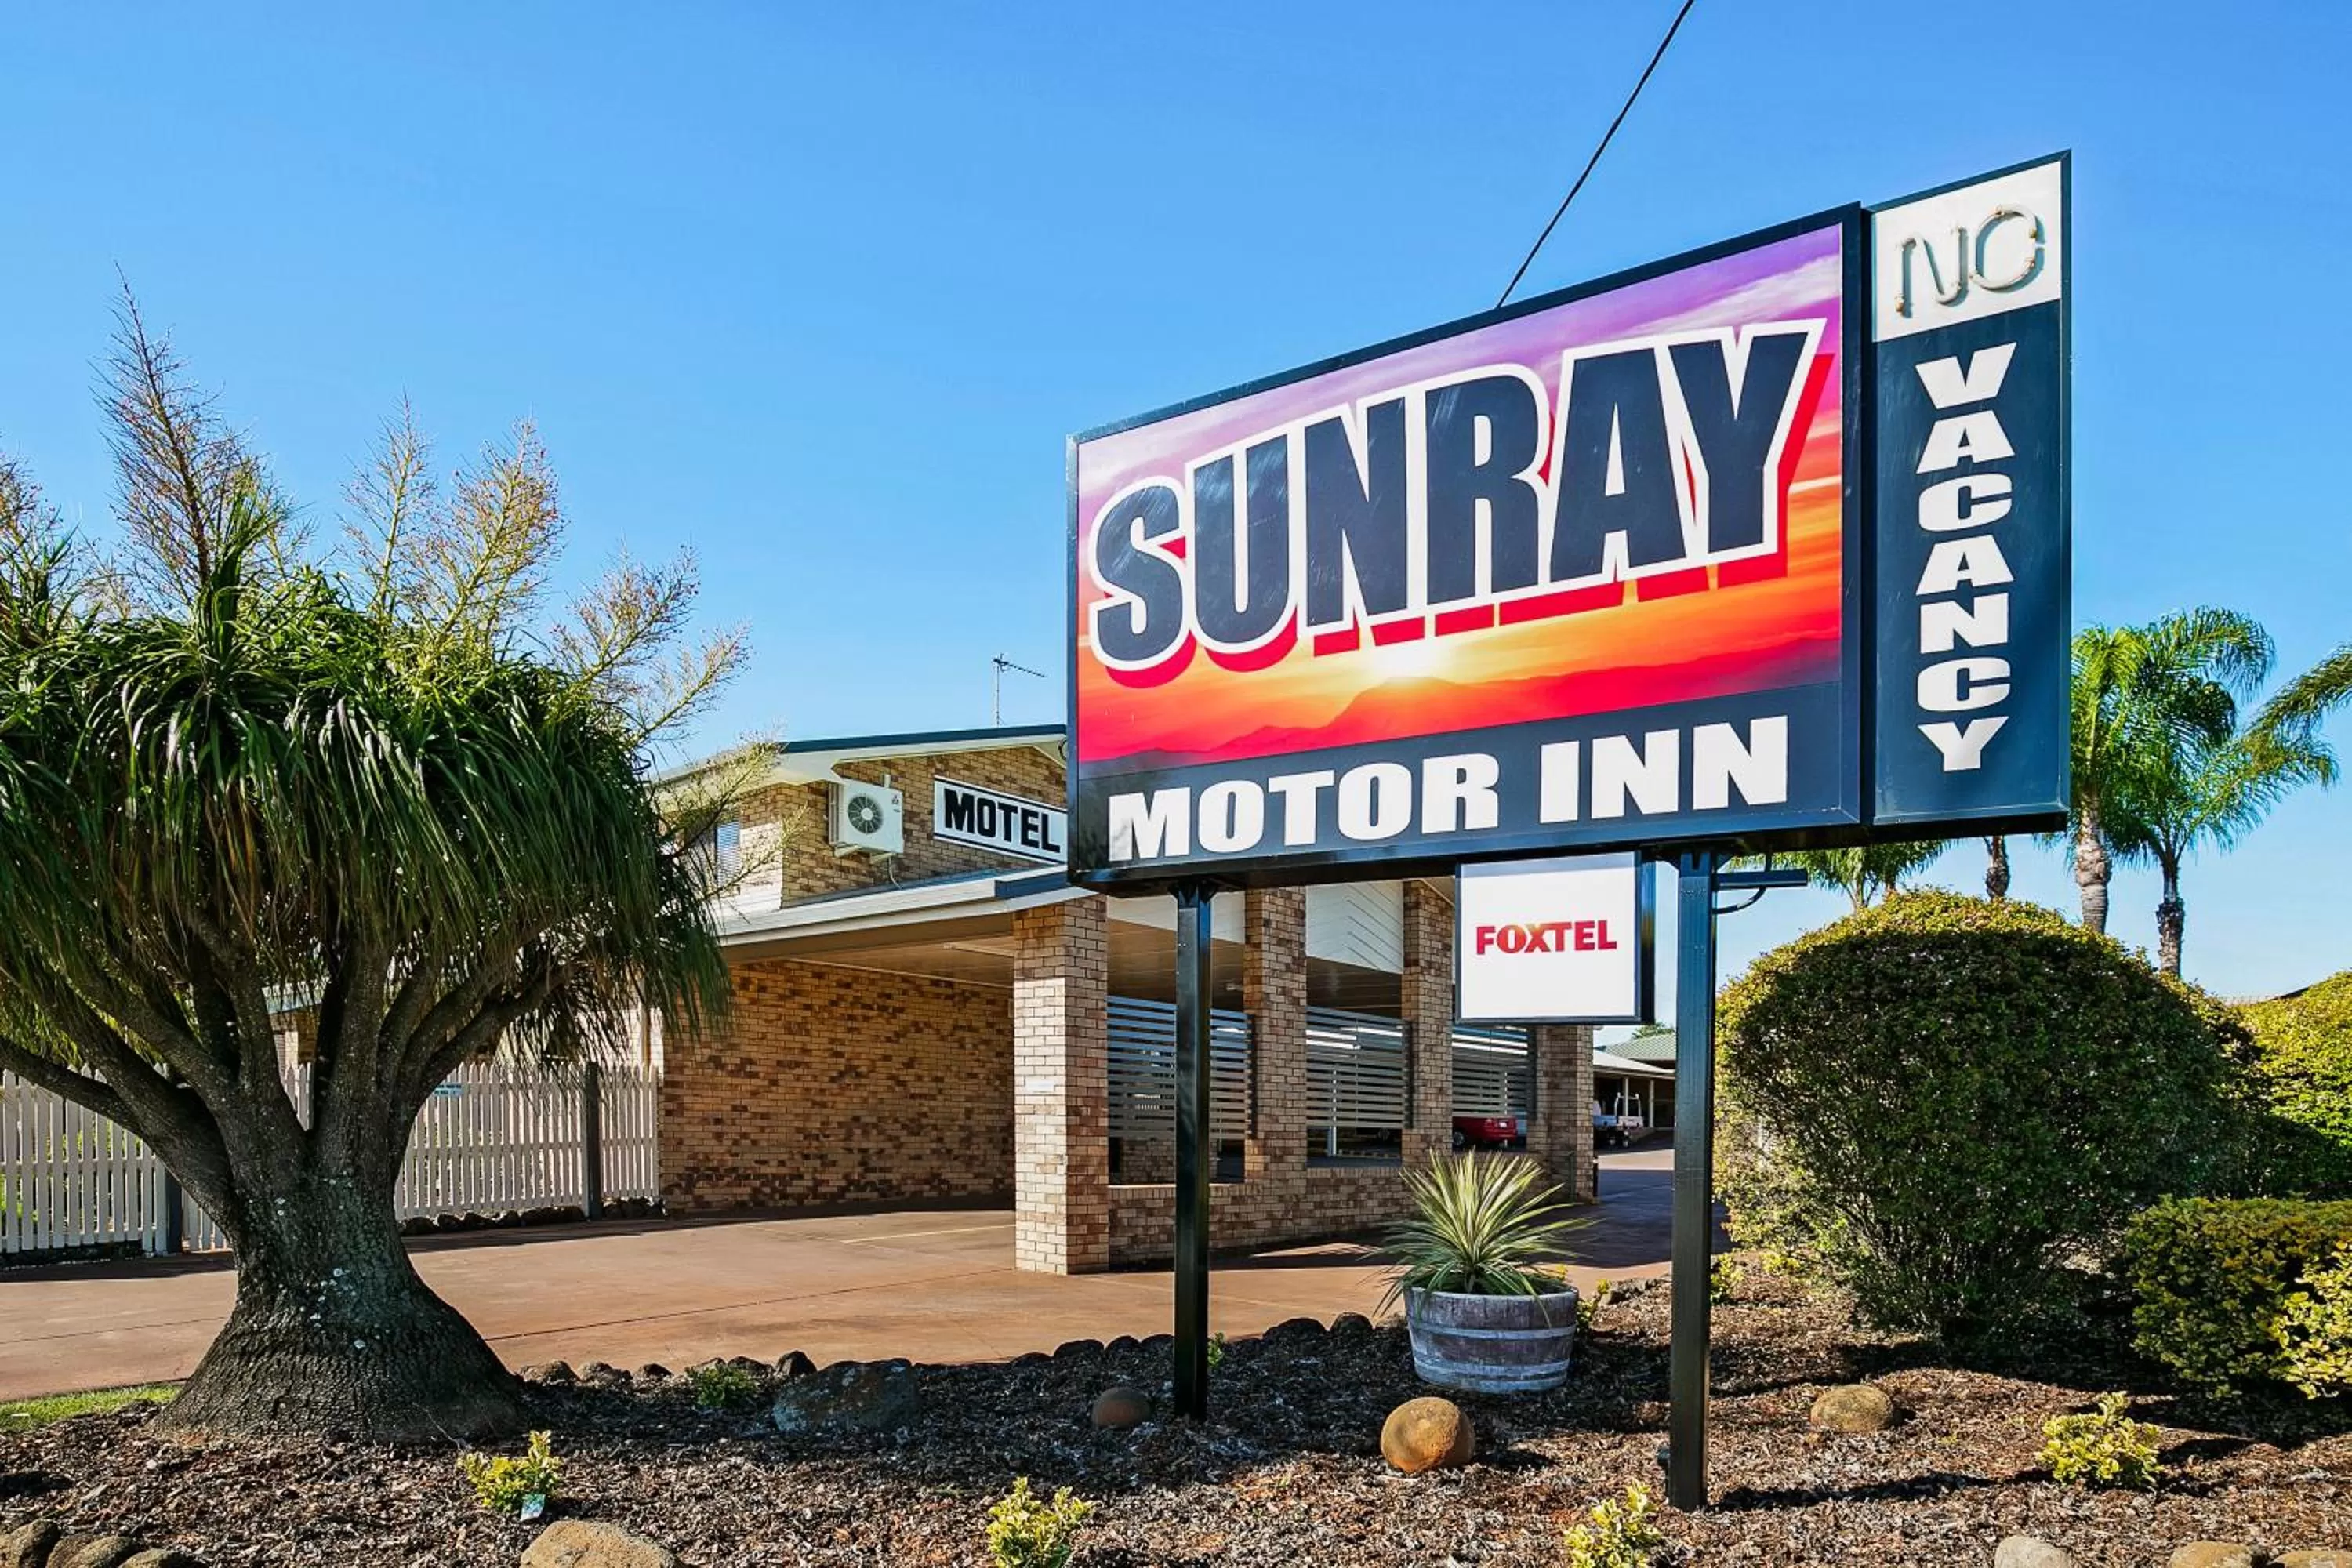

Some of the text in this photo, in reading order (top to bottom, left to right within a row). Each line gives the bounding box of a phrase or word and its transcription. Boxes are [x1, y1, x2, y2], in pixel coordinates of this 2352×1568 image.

[1896, 205, 2042, 317] NO
[1090, 318, 1828, 672] SUNRAY
[1915, 342, 2017, 772] VACANCY
[944, 789, 1061, 853] MOTEL
[1108, 715, 1789, 862] MOTOR INN
[1475, 919, 1618, 955] FOXTEL
